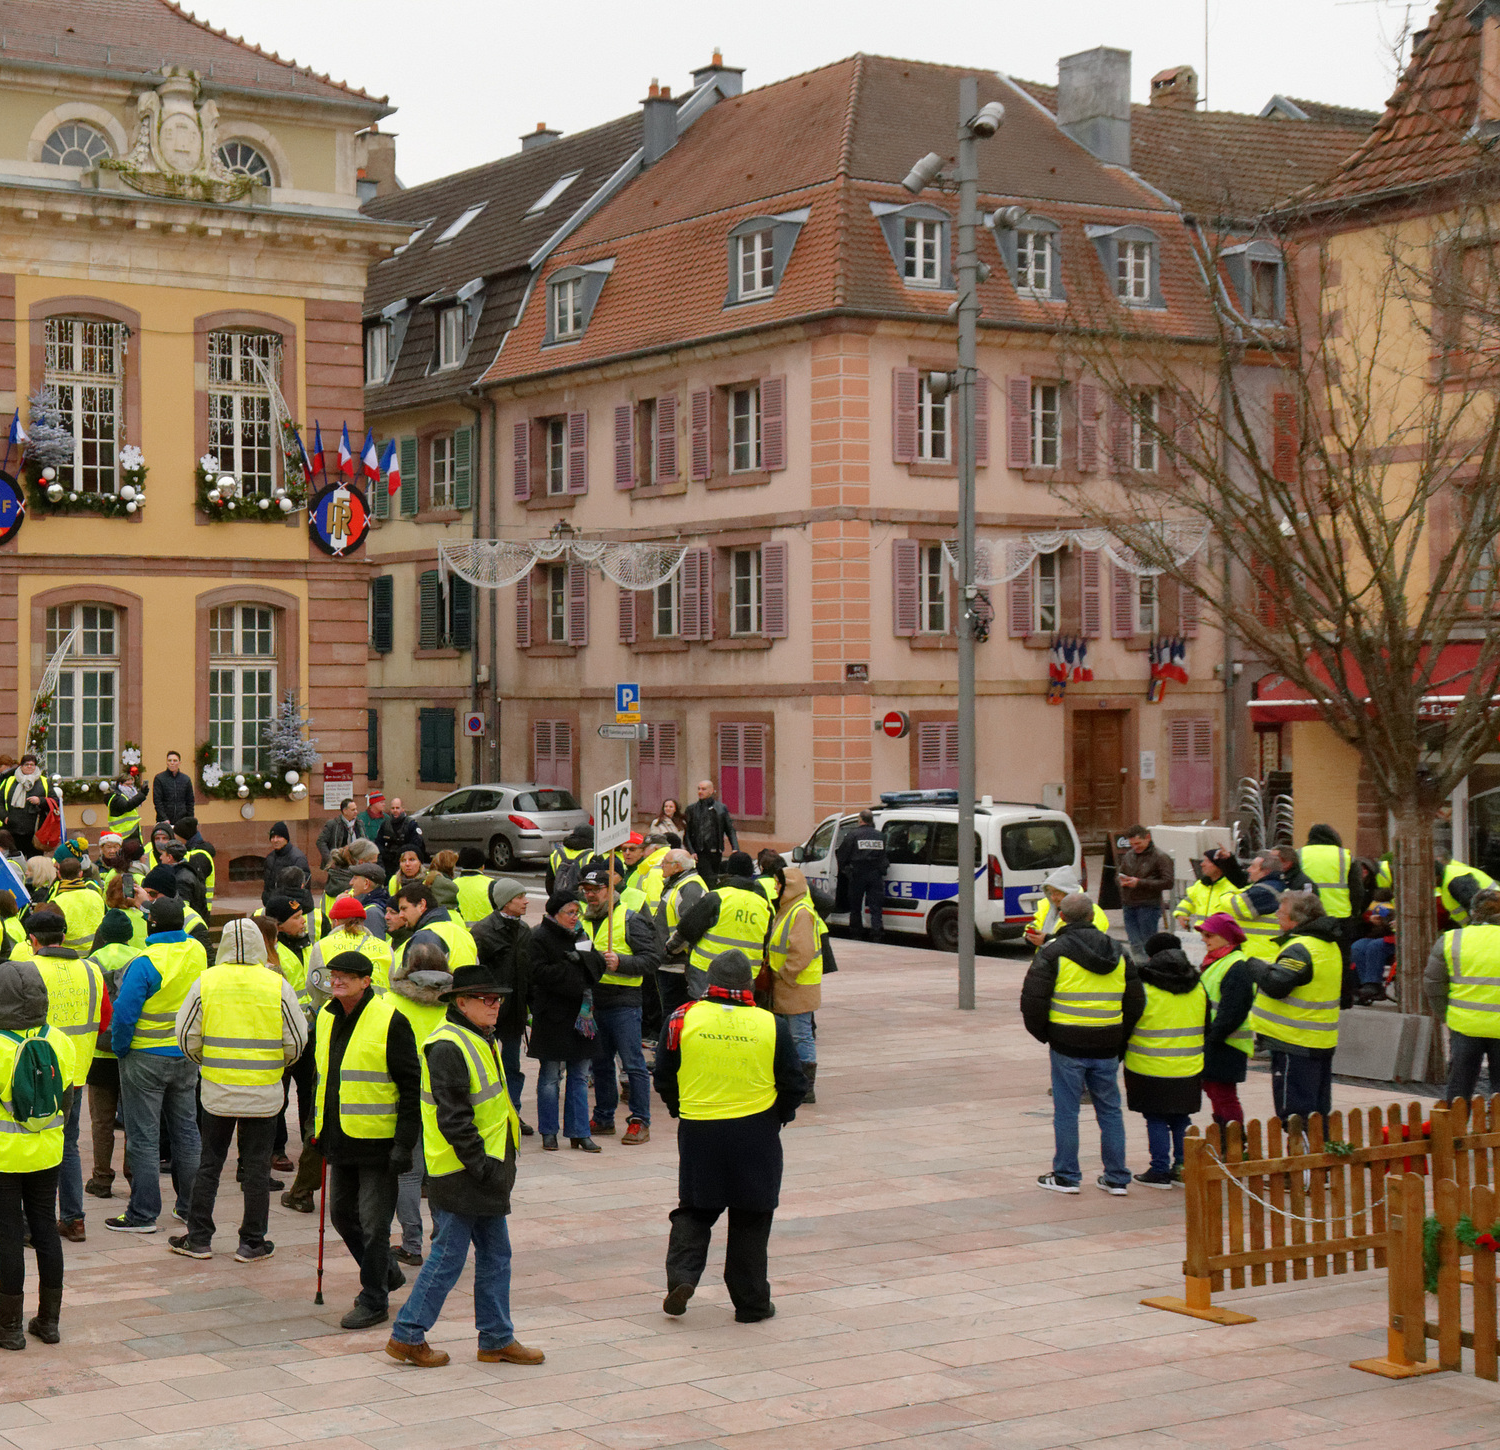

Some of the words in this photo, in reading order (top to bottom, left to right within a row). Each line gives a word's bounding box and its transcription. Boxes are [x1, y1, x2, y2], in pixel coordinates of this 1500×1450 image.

[622, 688, 634, 708] P
[601, 786, 629, 831] RIC
[860, 840, 883, 848] POLICE
[735, 909, 758, 925] RIC
